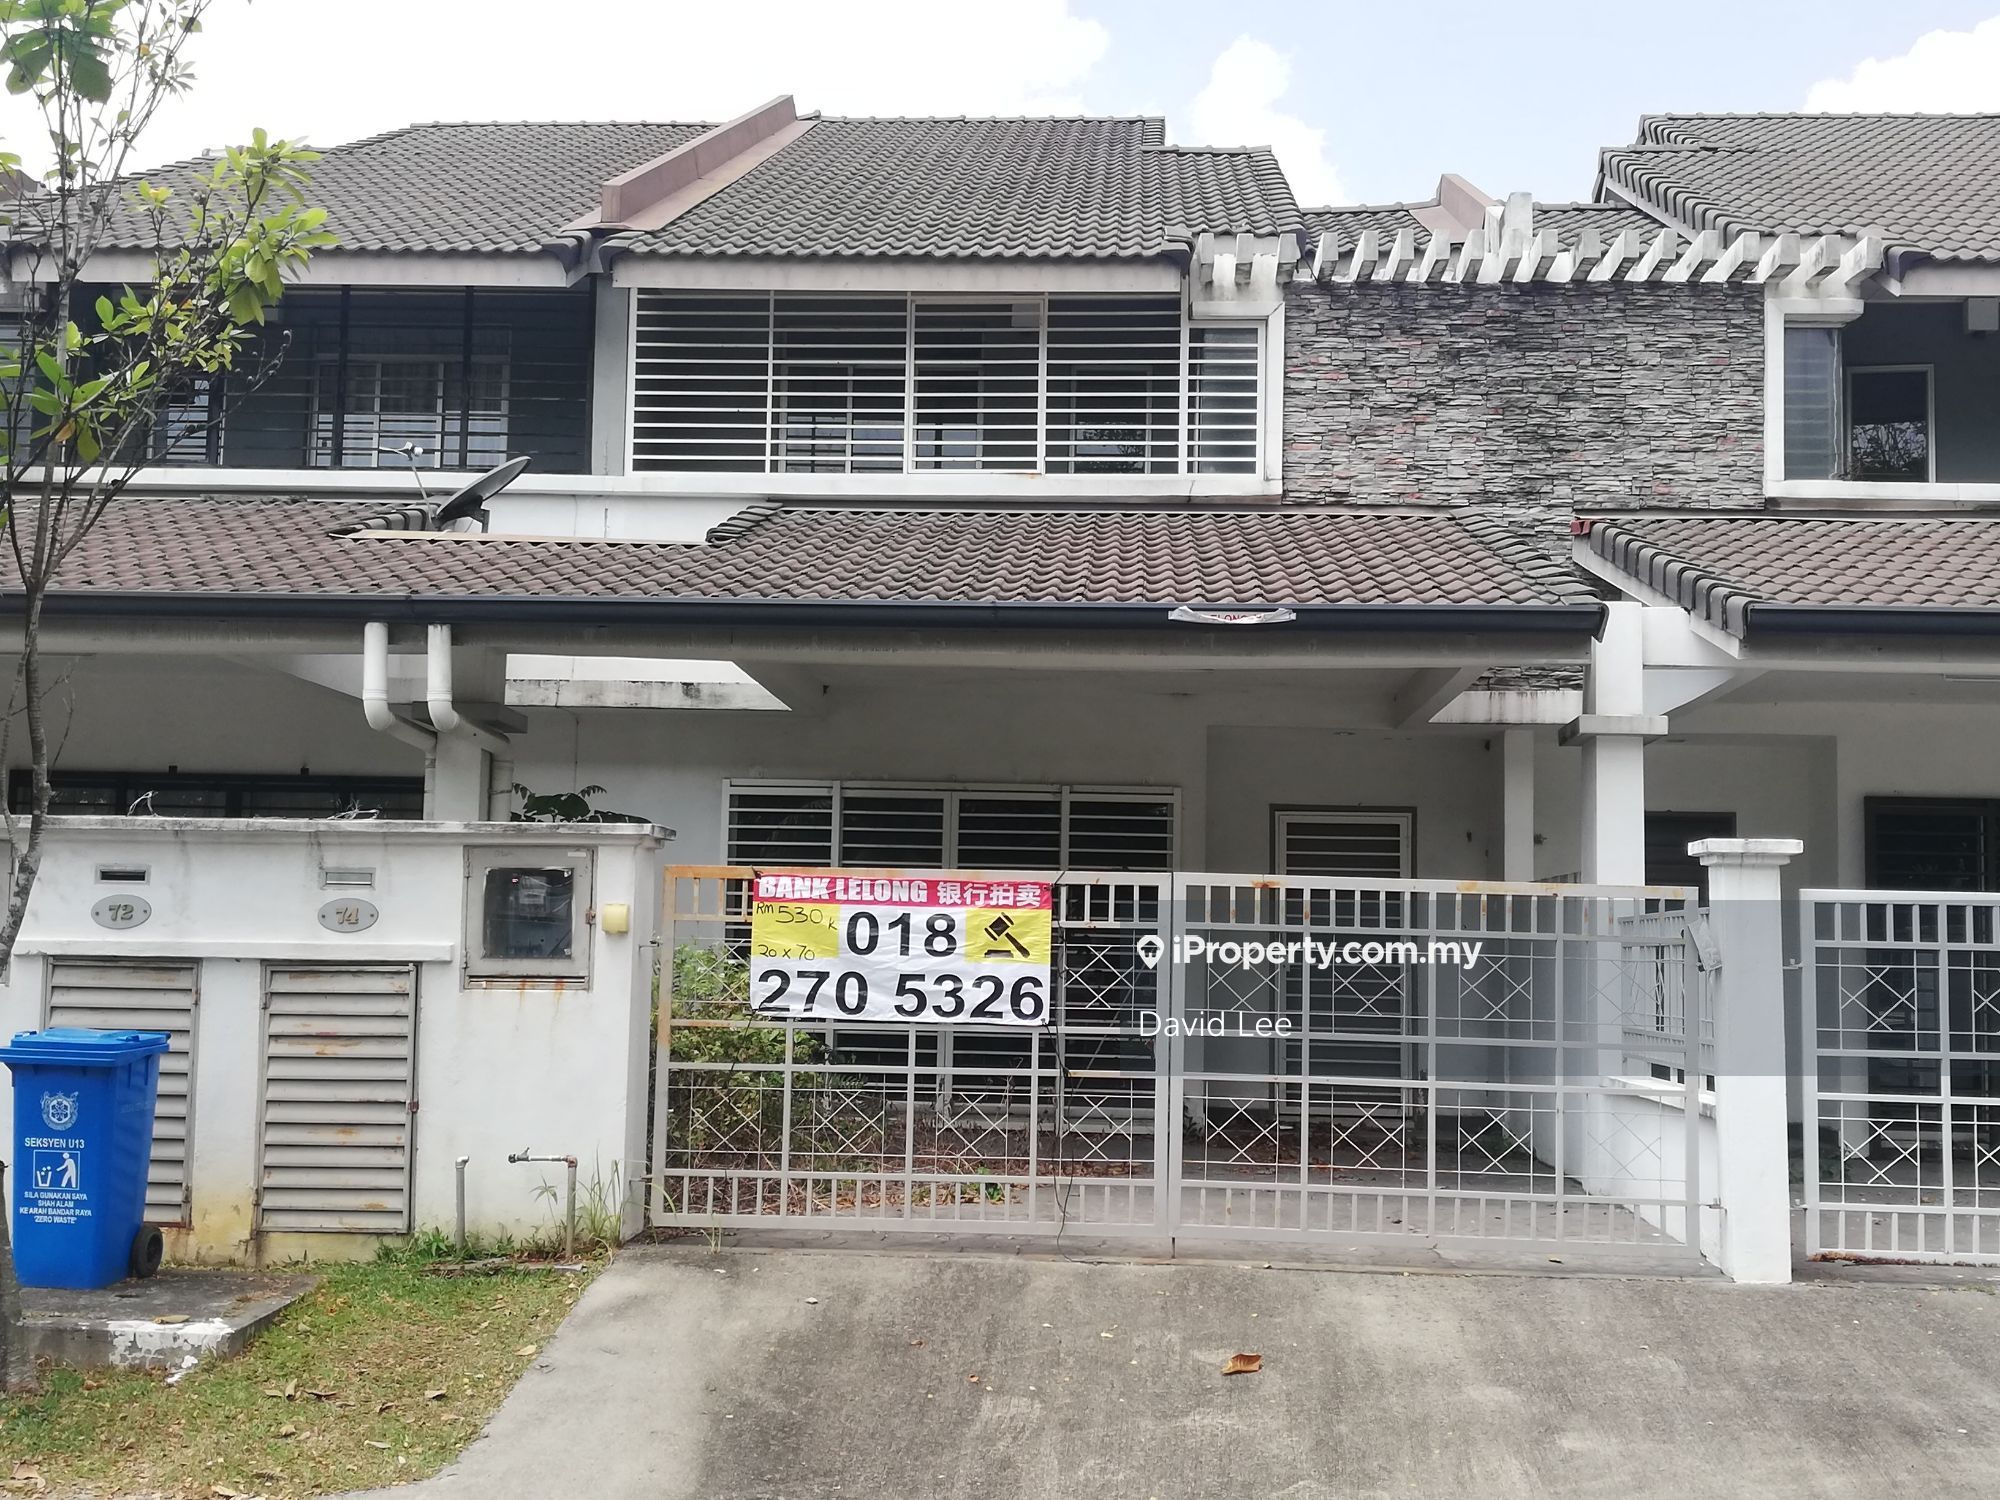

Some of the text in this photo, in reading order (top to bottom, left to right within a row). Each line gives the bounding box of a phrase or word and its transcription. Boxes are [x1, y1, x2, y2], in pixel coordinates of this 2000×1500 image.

[758, 876, 1041, 907] BANK LELONG 银行拍卖
[109, 904, 134, 921] 72
[336, 907, 359, 924] 74
[775, 907, 824, 924] 530
[846, 911, 957, 958] 018
[758, 944, 777, 957] 20
[796, 944, 815, 961] 70
[758, 969, 1045, 1021] 270 5326
[25, 1137, 85, 1149] SEKSYEN U13
[24, 1191, 39, 1199] SILA
[40, 1191, 71, 1200] GUNAKAN
[56, 1200, 74, 1208] ALAM
[29, 1207, 47, 1215] ARAH
[48, 1208, 74, 1216] BANDAR
[75, 1209, 92, 1217] RAYA
